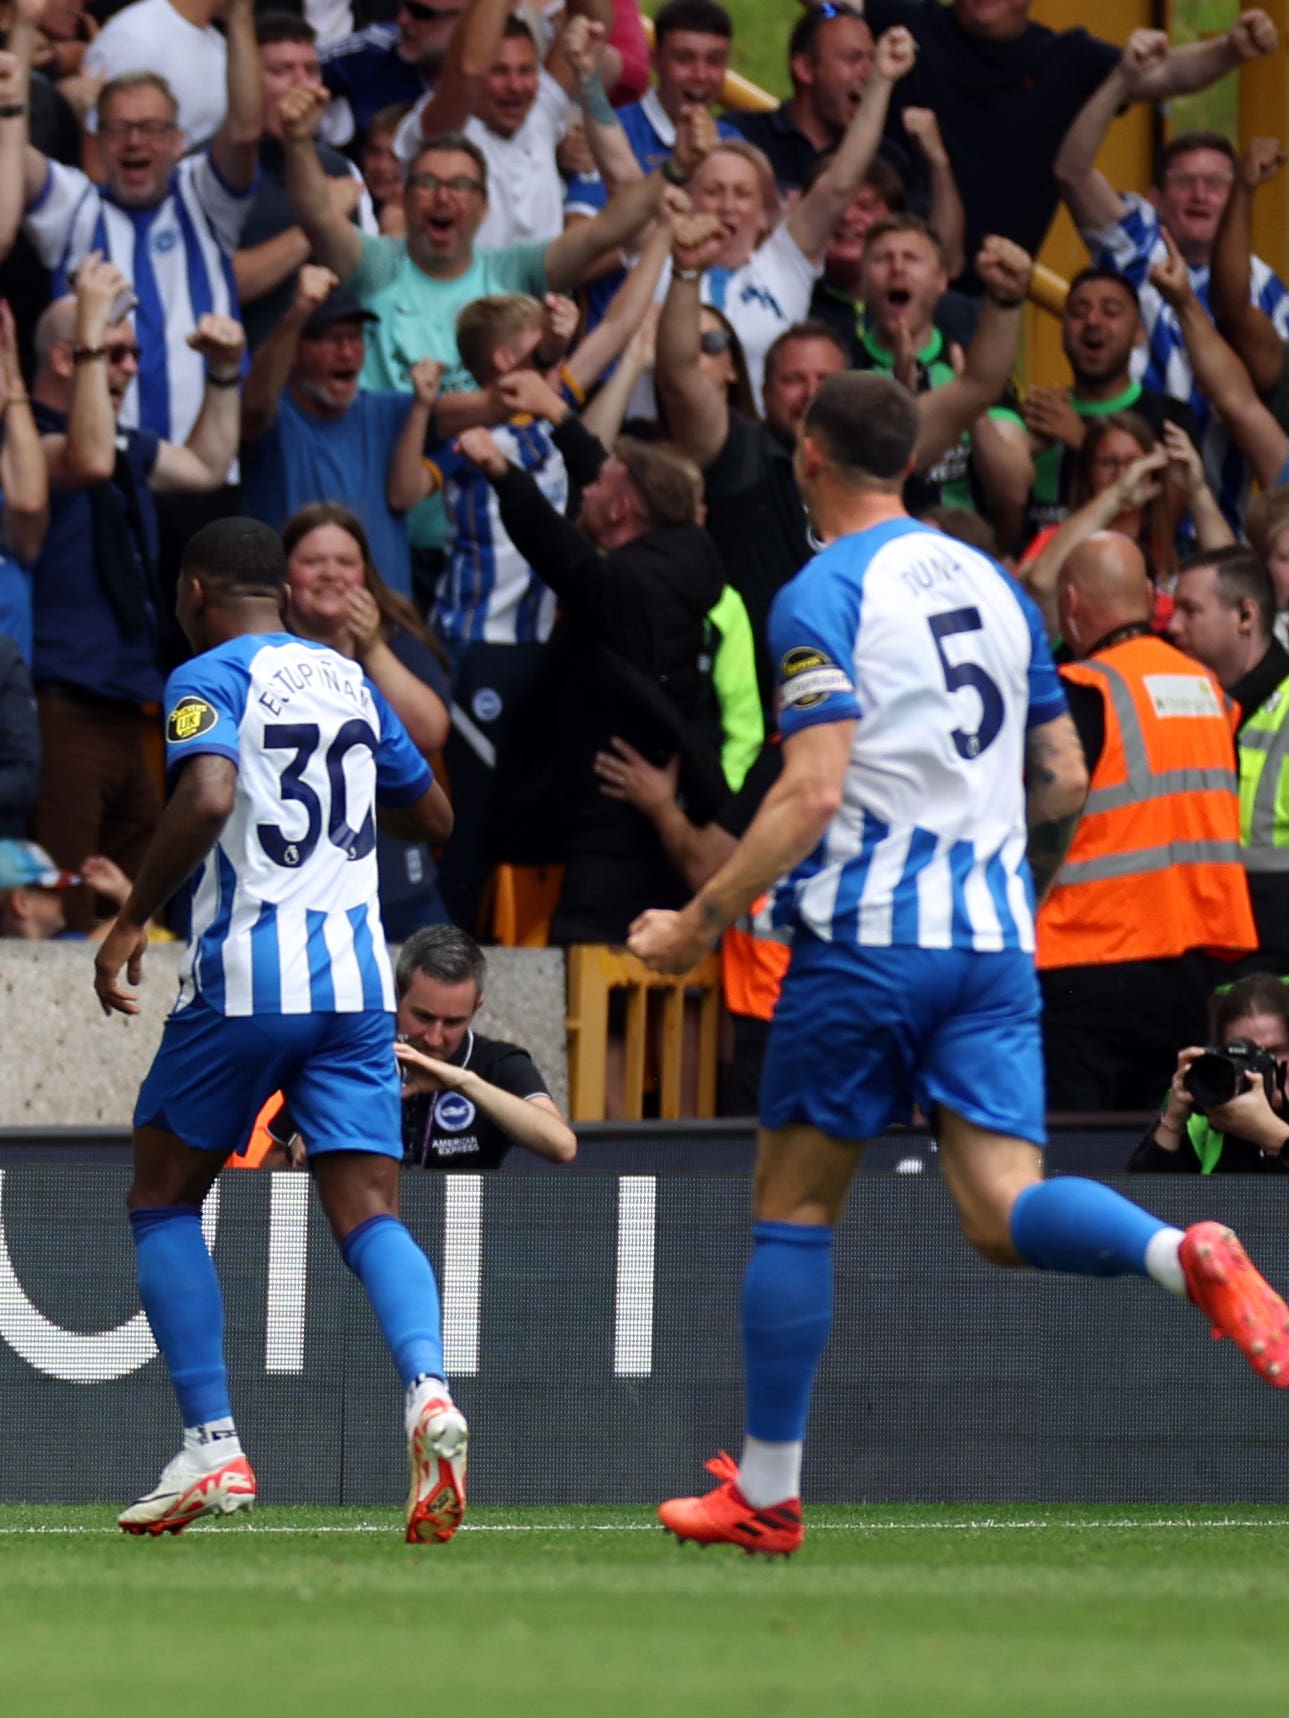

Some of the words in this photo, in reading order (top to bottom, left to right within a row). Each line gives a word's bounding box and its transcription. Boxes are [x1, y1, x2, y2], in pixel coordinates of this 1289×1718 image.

[901, 557, 964, 596] DUN
[927, 606, 1005, 759] 5
[257, 718, 379, 868] 30
[431, 1135, 478, 1148] AMERICAN
[437, 1144, 480, 1156] EXPRESS
